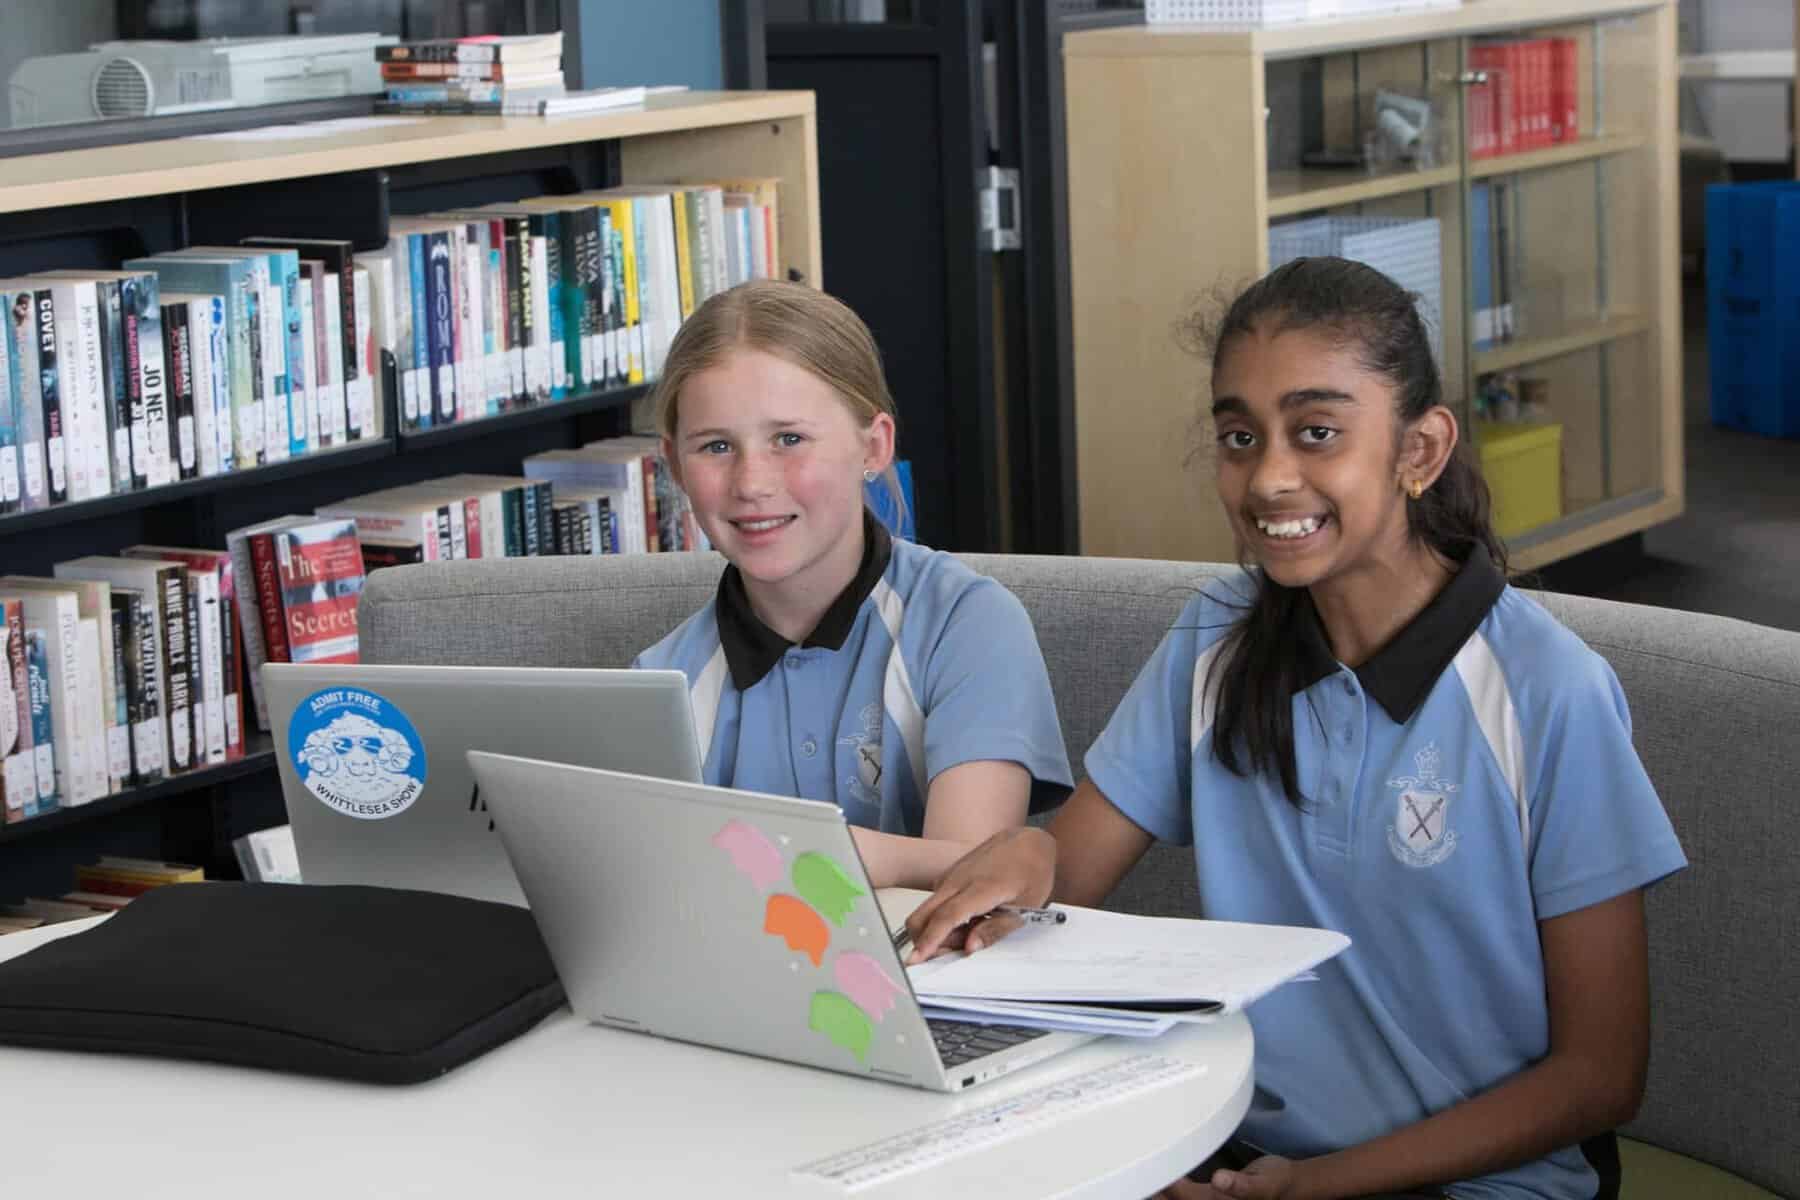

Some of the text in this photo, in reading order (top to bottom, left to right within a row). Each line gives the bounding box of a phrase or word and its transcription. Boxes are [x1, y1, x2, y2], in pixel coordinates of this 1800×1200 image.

[520, 230, 530, 268] SAW
[547, 237, 561, 287] SILVA
[575, 235, 585, 287] SILVA
[586, 231, 599, 283] SILVA
[39, 299, 56, 353] COVET
[523, 287, 534, 328] MAN
[144, 364, 161, 387] JO
[285, 552, 321, 580] The
[165, 577, 182, 616] ANNIE
[260, 560, 279, 624] Secrets
[168, 618, 186, 666] PROULX
[291, 608, 358, 637] Secret
[143, 636, 158, 702] WHITES
[309, 690, 343, 712] ADMIT
[346, 690, 382, 710] FREE
[315, 780, 418, 815] WHITTLESEA SHOW
